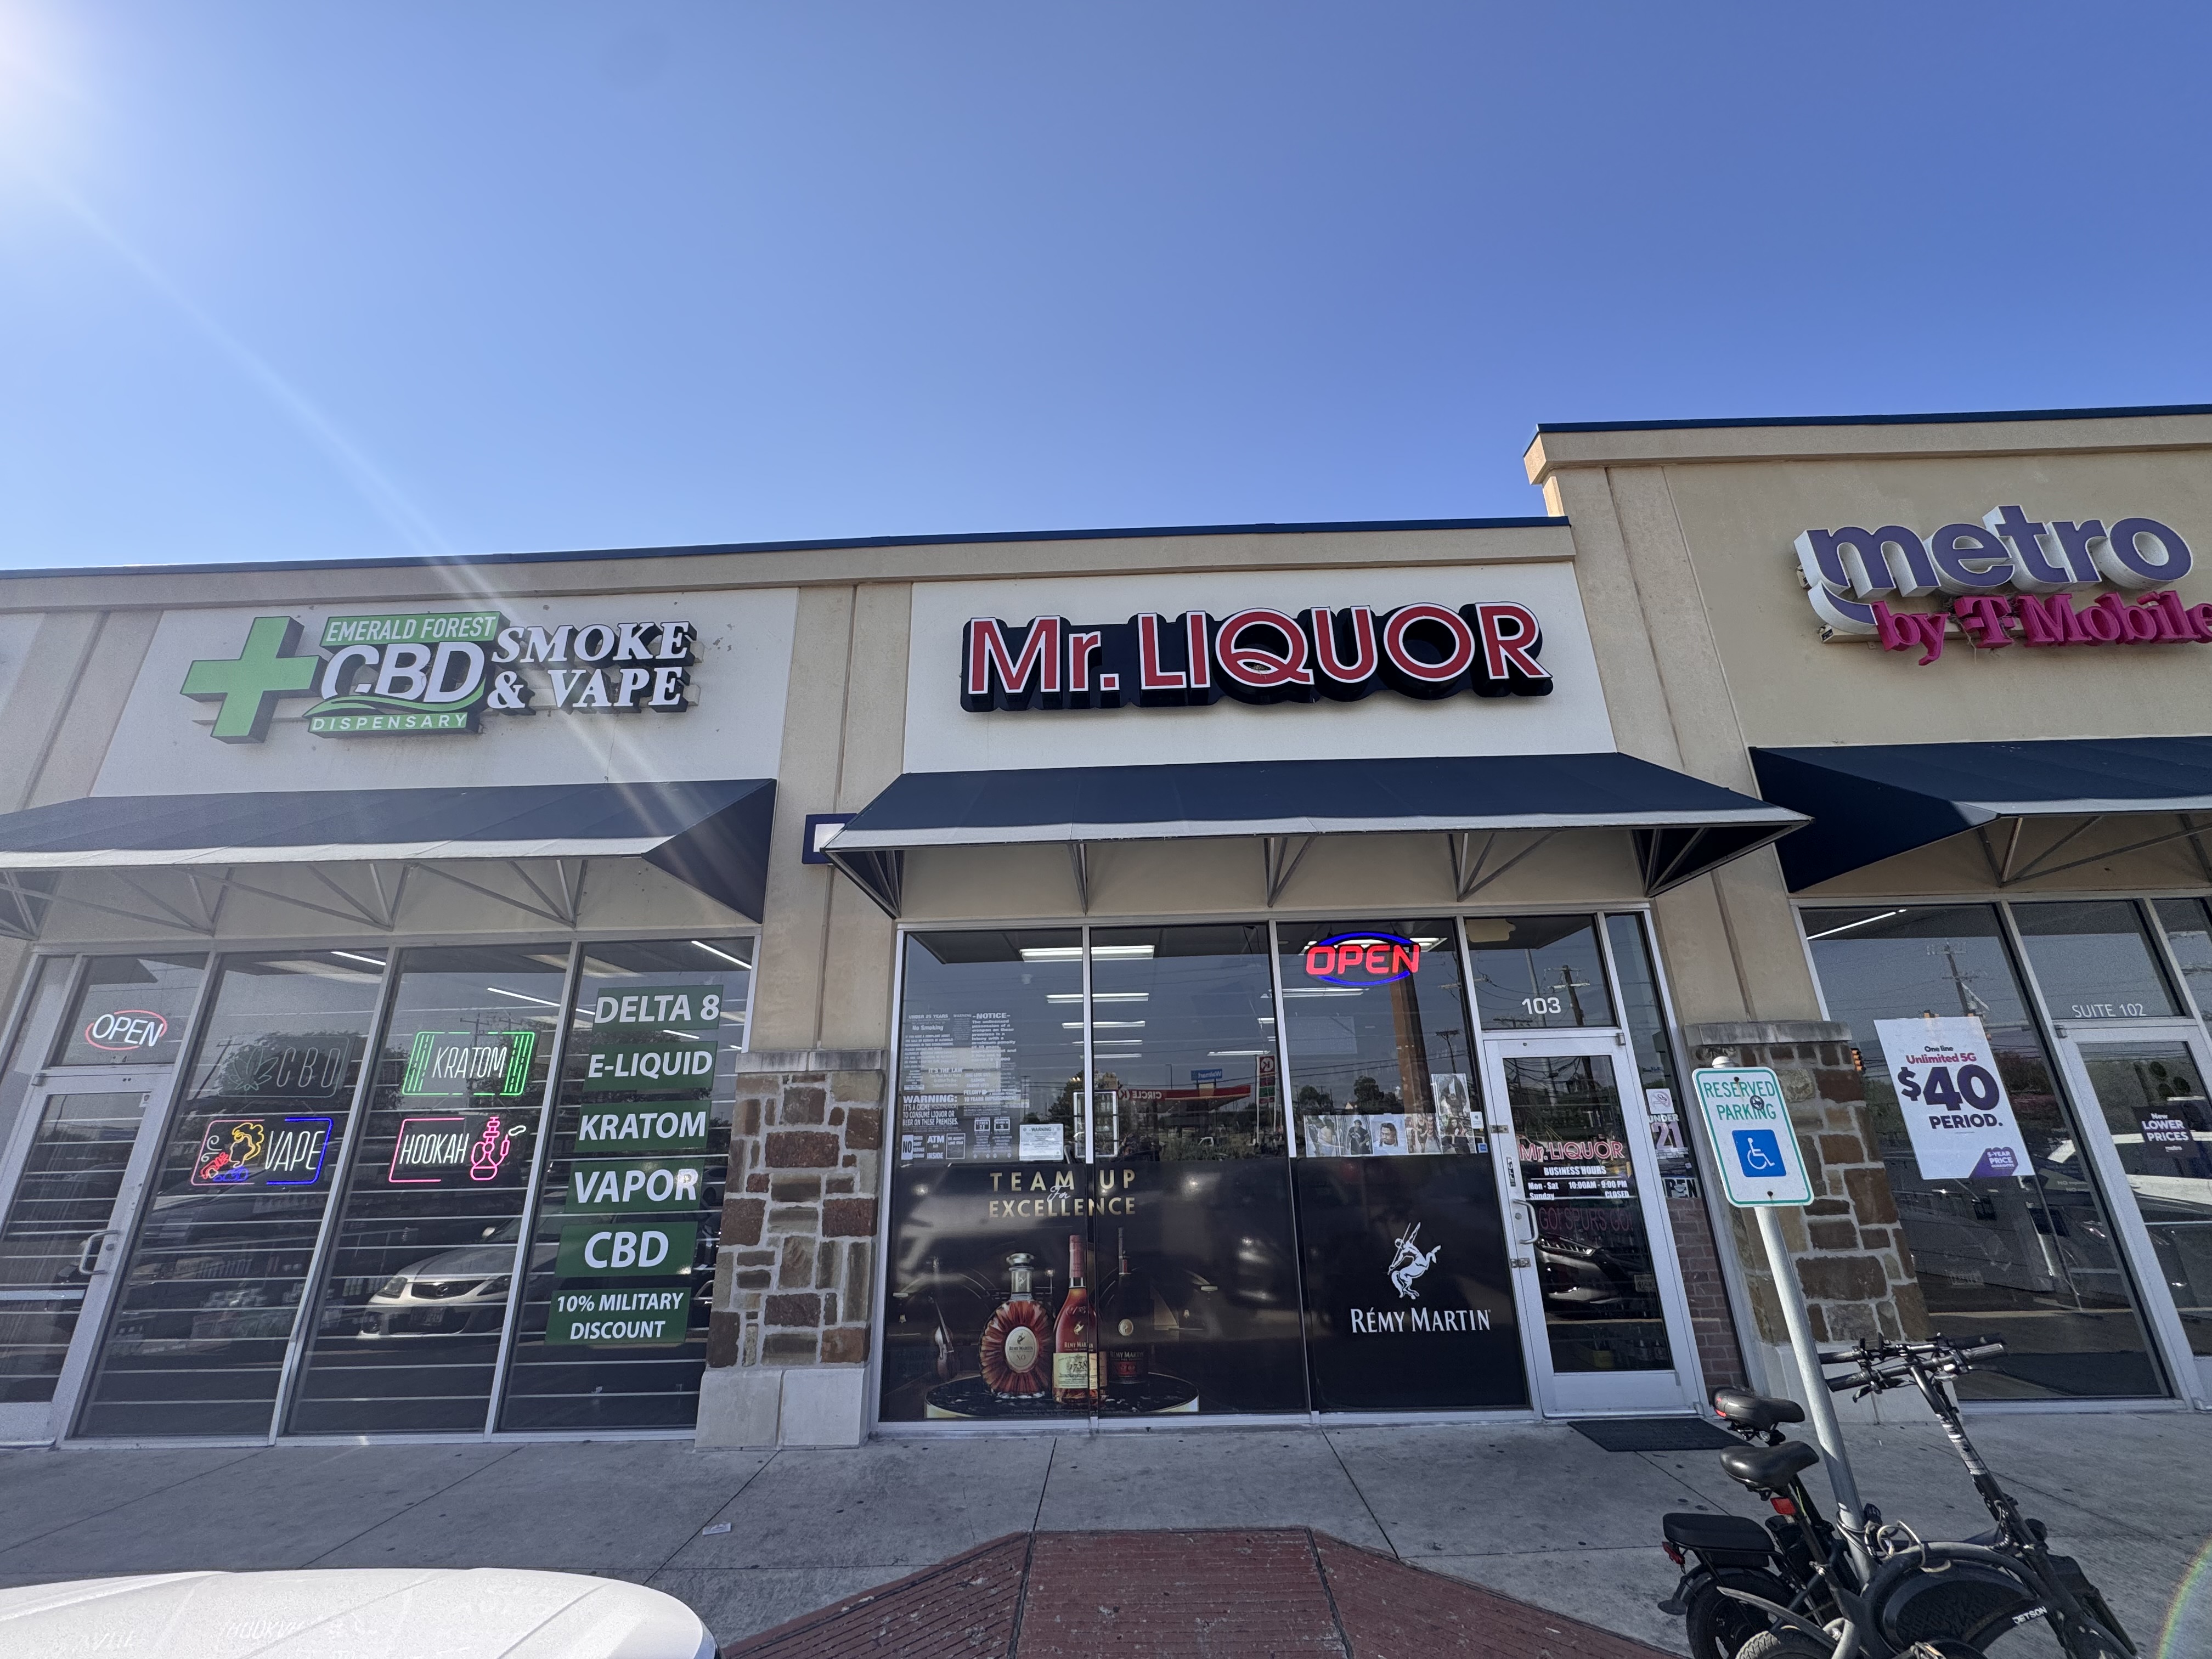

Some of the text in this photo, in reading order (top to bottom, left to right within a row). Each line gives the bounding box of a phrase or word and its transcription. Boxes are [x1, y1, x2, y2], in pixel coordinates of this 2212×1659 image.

[1794, 505, 2193, 601] metro
[326, 616, 496, 641] EMERALD FOREST
[1871, 600, 1951, 666] by
[492, 621, 688, 663] SMOKE
[968, 602, 1553, 694] Mr. LIQUOR
[321, 641, 484, 702] CBD
[487, 667, 682, 708] & VAPE
[312, 714, 466, 730] DISPENSARY
[1306, 944, 1420, 975] OPEN
[594, 994, 720, 1024] DELTA 8
[1521, 997, 1561, 1014] 103
[2072, 1003, 2147, 1018] SUITE 102
[92, 1014, 163, 1046] OPEN
[276, 1047, 341, 1088] CBD
[432, 1046, 507, 1079] KRATOM
[588, 1051, 713, 1079] E-LIQUID
[1905, 1053, 1977, 1064] Unlimited 5G
[1703, 1081, 1775, 1098] RESERVED
[1897, 1064, 2000, 1111] $40
[903, 1094, 957, 1103] WARNING:
[1648, 1114, 1679, 1124] UNDER
[1717, 1103, 1776, 1120] PARKING
[1929, 1114, 2004, 1129] PERIOD.
[579, 1111, 706, 1140] KRATOM
[1651, 1121, 1684, 1150] 21
[2142, 1120, 2186, 1130] LOWER
[902, 1141, 912, 1153] NO
[2146, 1131, 2189, 1142] PRICES
[264, 1130, 325, 1171] VAPE
[399, 1133, 470, 1165] HOOKAH
[1519, 1141, 1625, 1162] Mr. LIQUOR
[990, 1169, 1135, 1192] TEAM UP
[1543, 1165, 1606, 1176] BUSINESS HOURS
[574, 1169, 698, 1203] VAPOR
[1047, 1183, 1071, 1203] For
[1528, 1182, 1543, 1190] Mon
[1547, 1182, 1559, 1190] Sat
[1568, 1181, 1596, 1189] 10:00AM
[1601, 1181, 1616, 1189] 9:00
[1530, 1192, 1555, 1200] Sunday
[1662, 1179, 1699, 1198] PEN
[989, 1197, 1135, 1217] EXCELLENCE
[584, 1231, 669, 1269] CBD
[556, 1292, 684, 1312] 10% MILITARY
[570, 1320, 666, 1340] DISCOUNT
[1350, 1307, 1491, 1333] RÉMY MARTIN
[1070, 1361, 1087, 1372] 1738
[2012, 1606, 2047, 1624] JETSON
